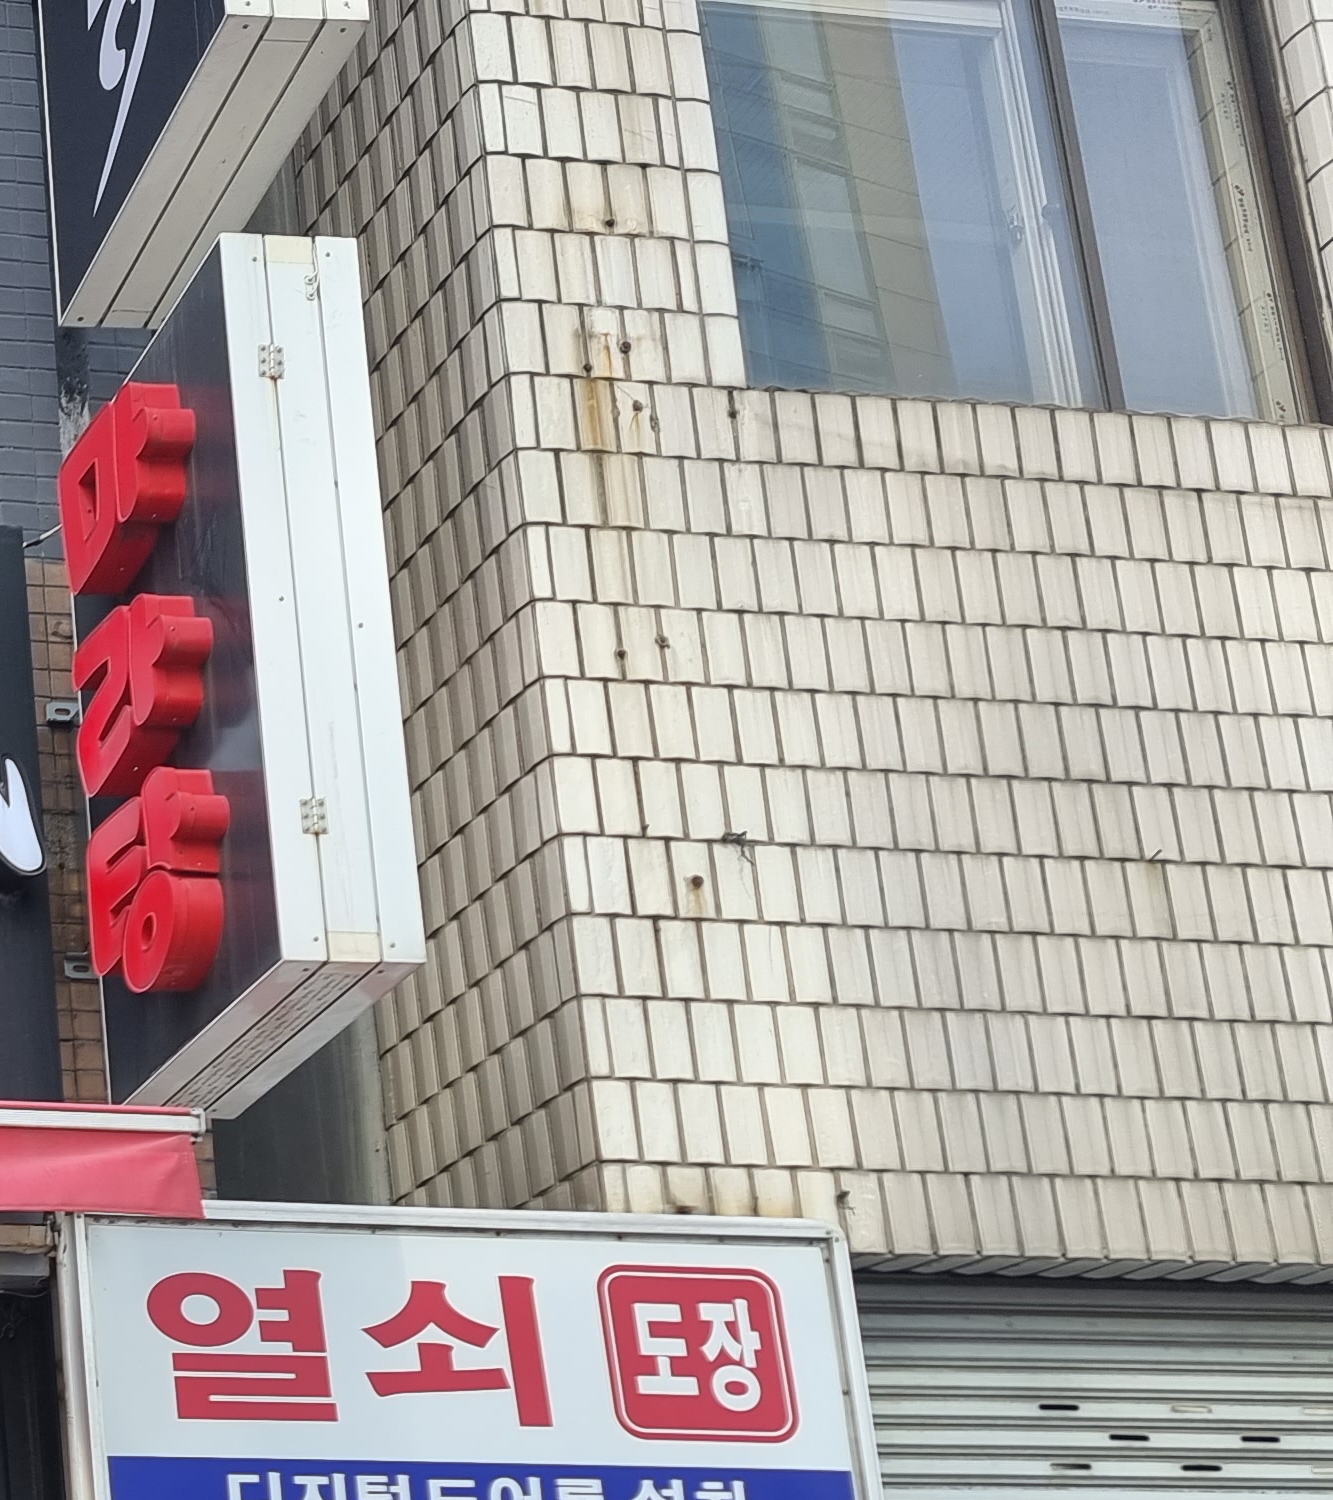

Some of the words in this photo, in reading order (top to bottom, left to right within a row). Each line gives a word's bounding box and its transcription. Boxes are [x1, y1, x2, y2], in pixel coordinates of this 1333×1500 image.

[58, 381, 230, 993] 마라탕
[145, 1268, 553, 1428] 열쇠
[632, 1297, 761, 1412] 도장
